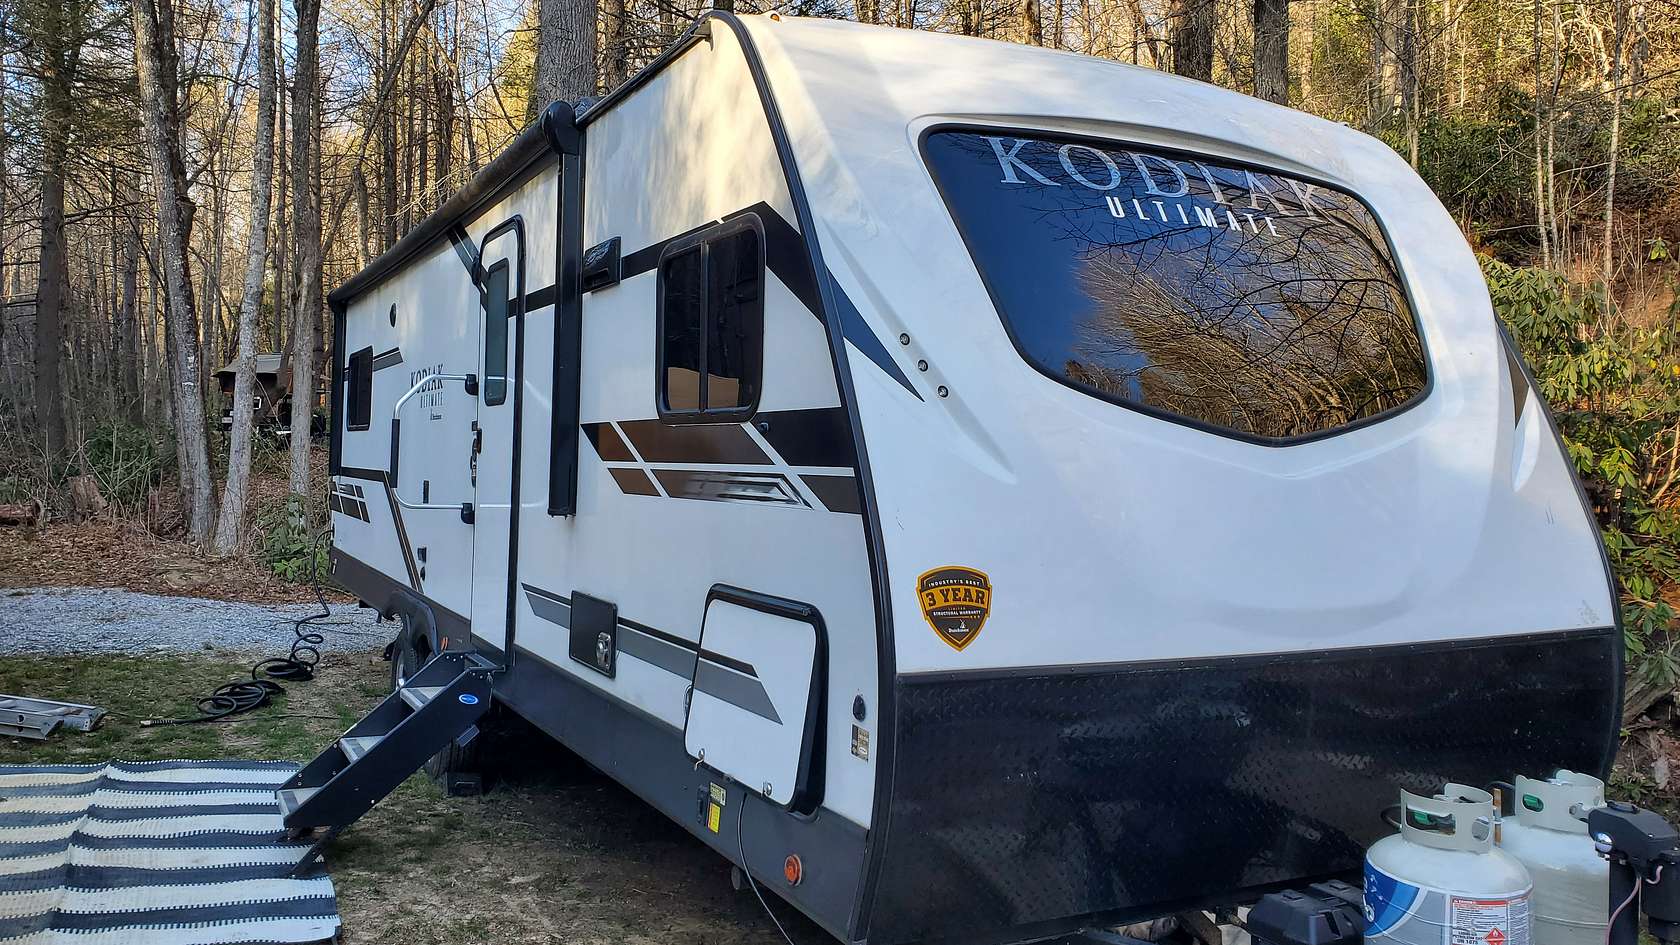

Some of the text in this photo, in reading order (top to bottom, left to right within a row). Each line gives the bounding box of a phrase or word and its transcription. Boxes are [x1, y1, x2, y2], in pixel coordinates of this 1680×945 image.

[980, 136, 1346, 228] KODIAK
[1105, 196, 1281, 237] ULTIMATE
[410, 363, 443, 393] KODIAK
[926, 587, 985, 607] 3 YEAR
[928, 579, 963, 587] INDUSTRY'S
